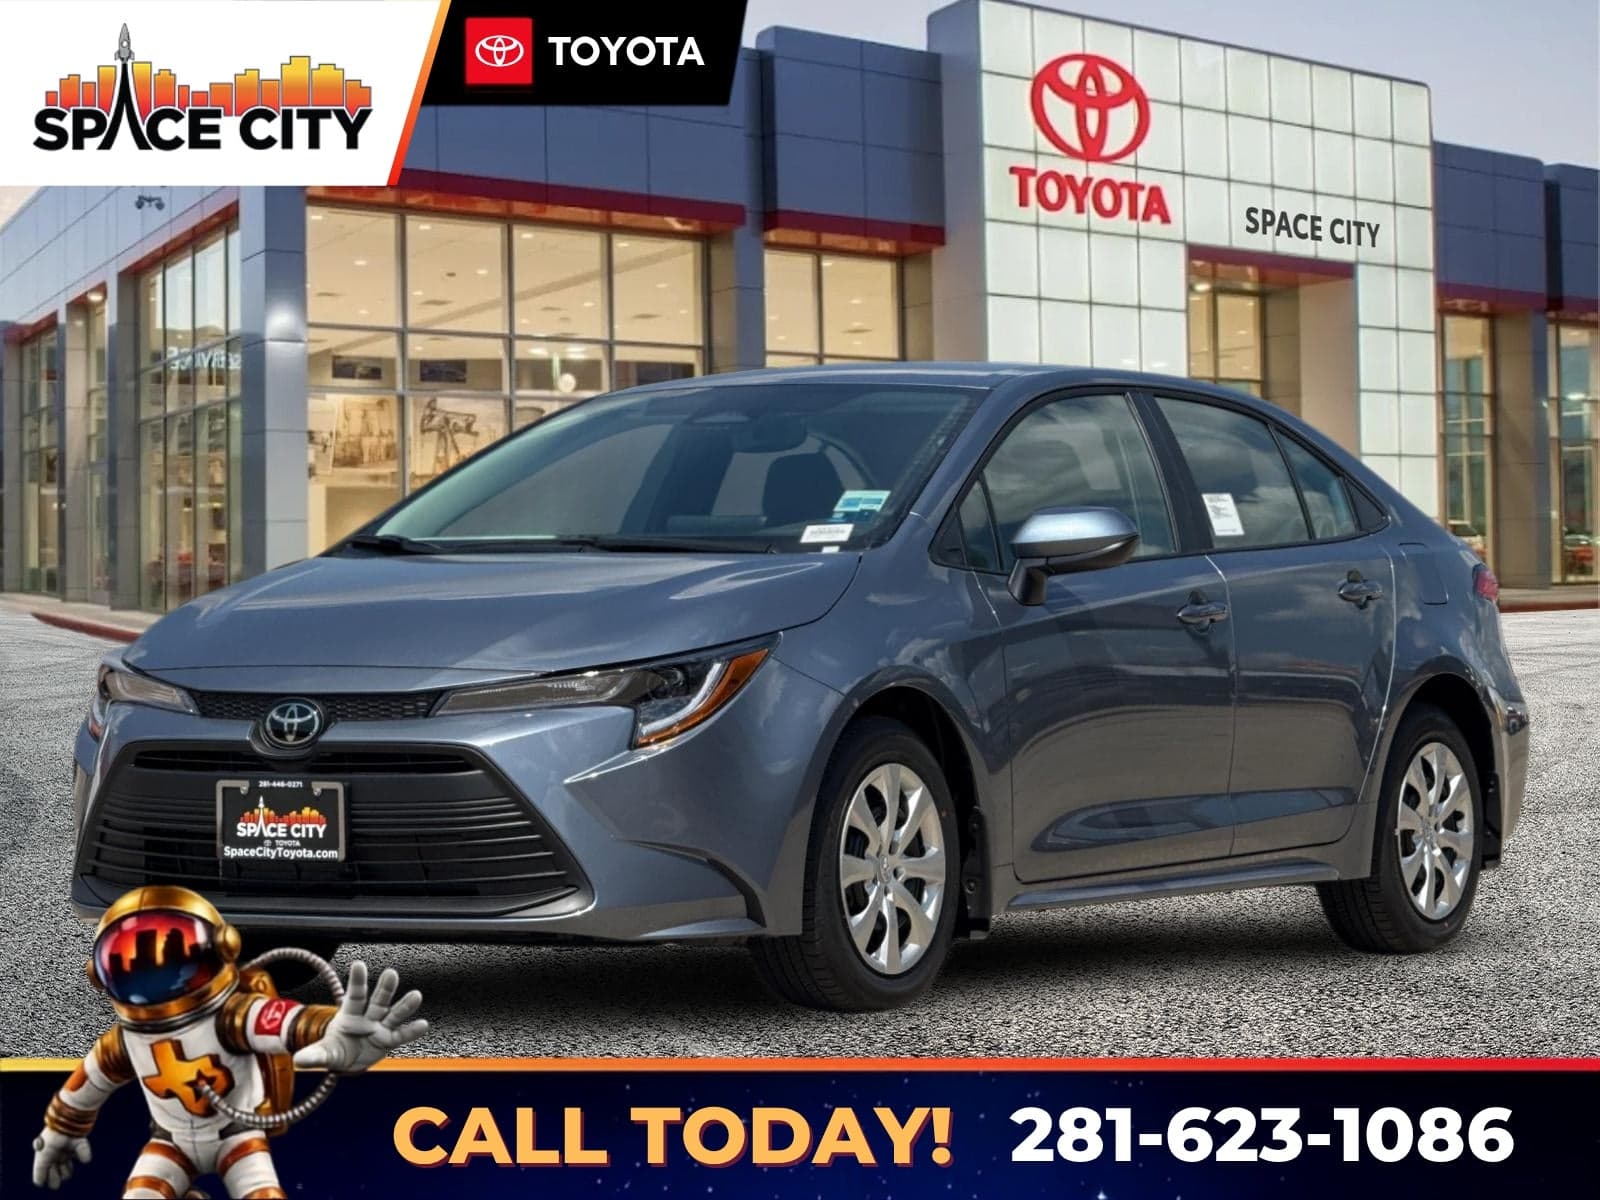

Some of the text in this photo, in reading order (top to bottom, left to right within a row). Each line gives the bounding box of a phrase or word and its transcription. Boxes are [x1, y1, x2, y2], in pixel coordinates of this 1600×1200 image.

[1009, 166, 1171, 224] TOYOTA
[1245, 206, 1381, 248] SPACE CITY
[290, 823, 327, 838] CITY
[275, 839, 301, 847] TOYOTA
[223, 846, 338, 860] SpaceCityToyota.com
